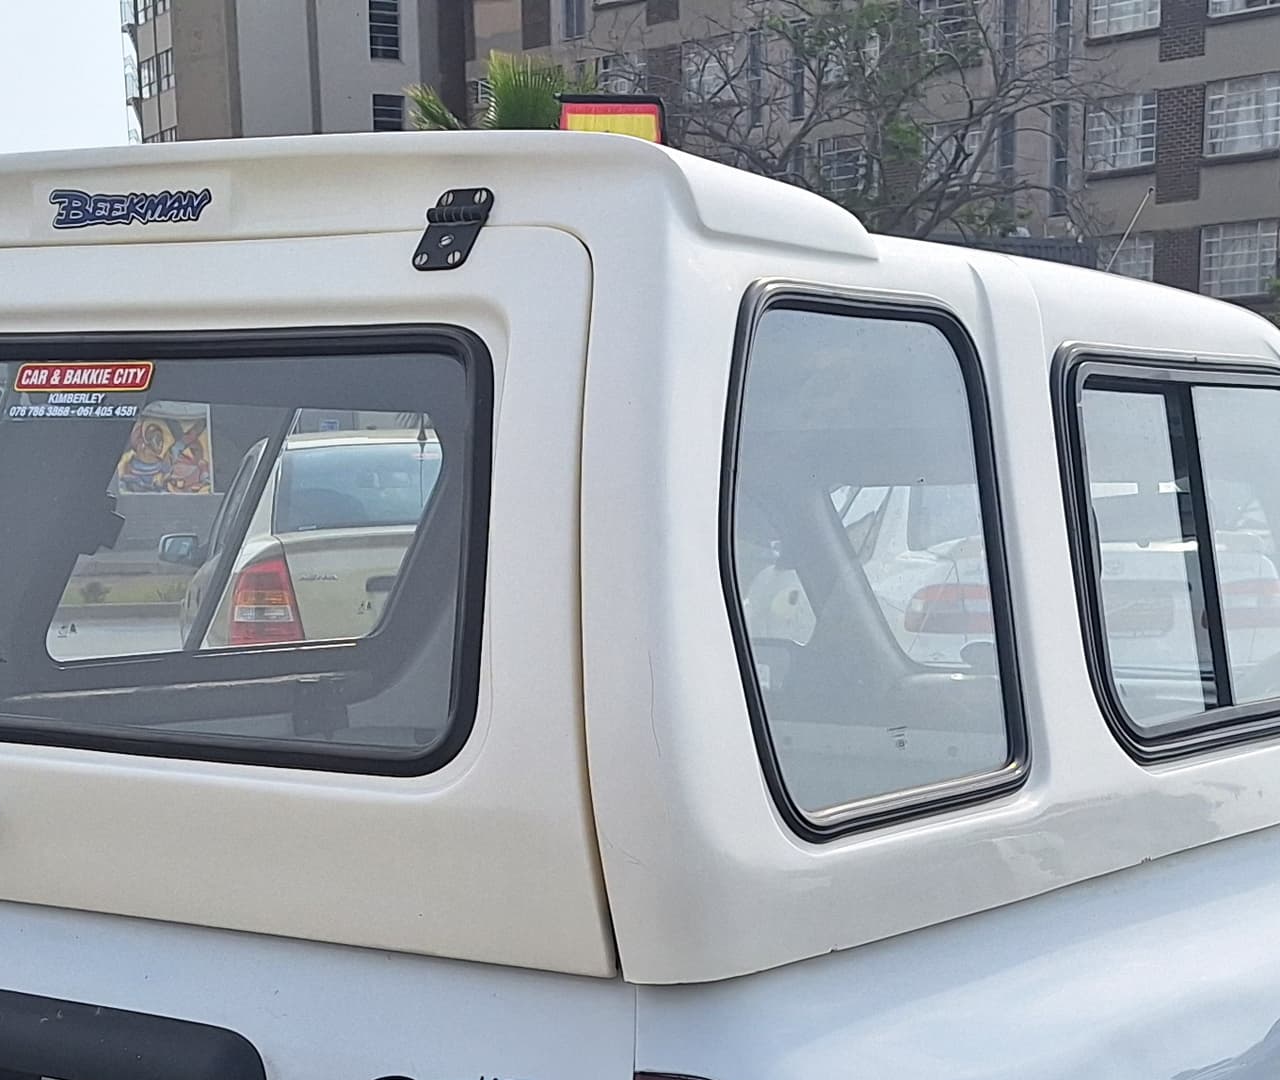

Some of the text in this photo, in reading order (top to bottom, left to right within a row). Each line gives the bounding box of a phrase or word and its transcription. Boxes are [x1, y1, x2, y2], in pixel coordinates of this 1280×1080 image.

[49, 188, 213, 229] BEEKMAN
[21, 368, 146, 385] CAR & BAKKIE CITY
[48, 393, 106, 404] KIMBERLEY
[94, 406, 113, 417] 405
[114, 406, 138, 417] 4581
